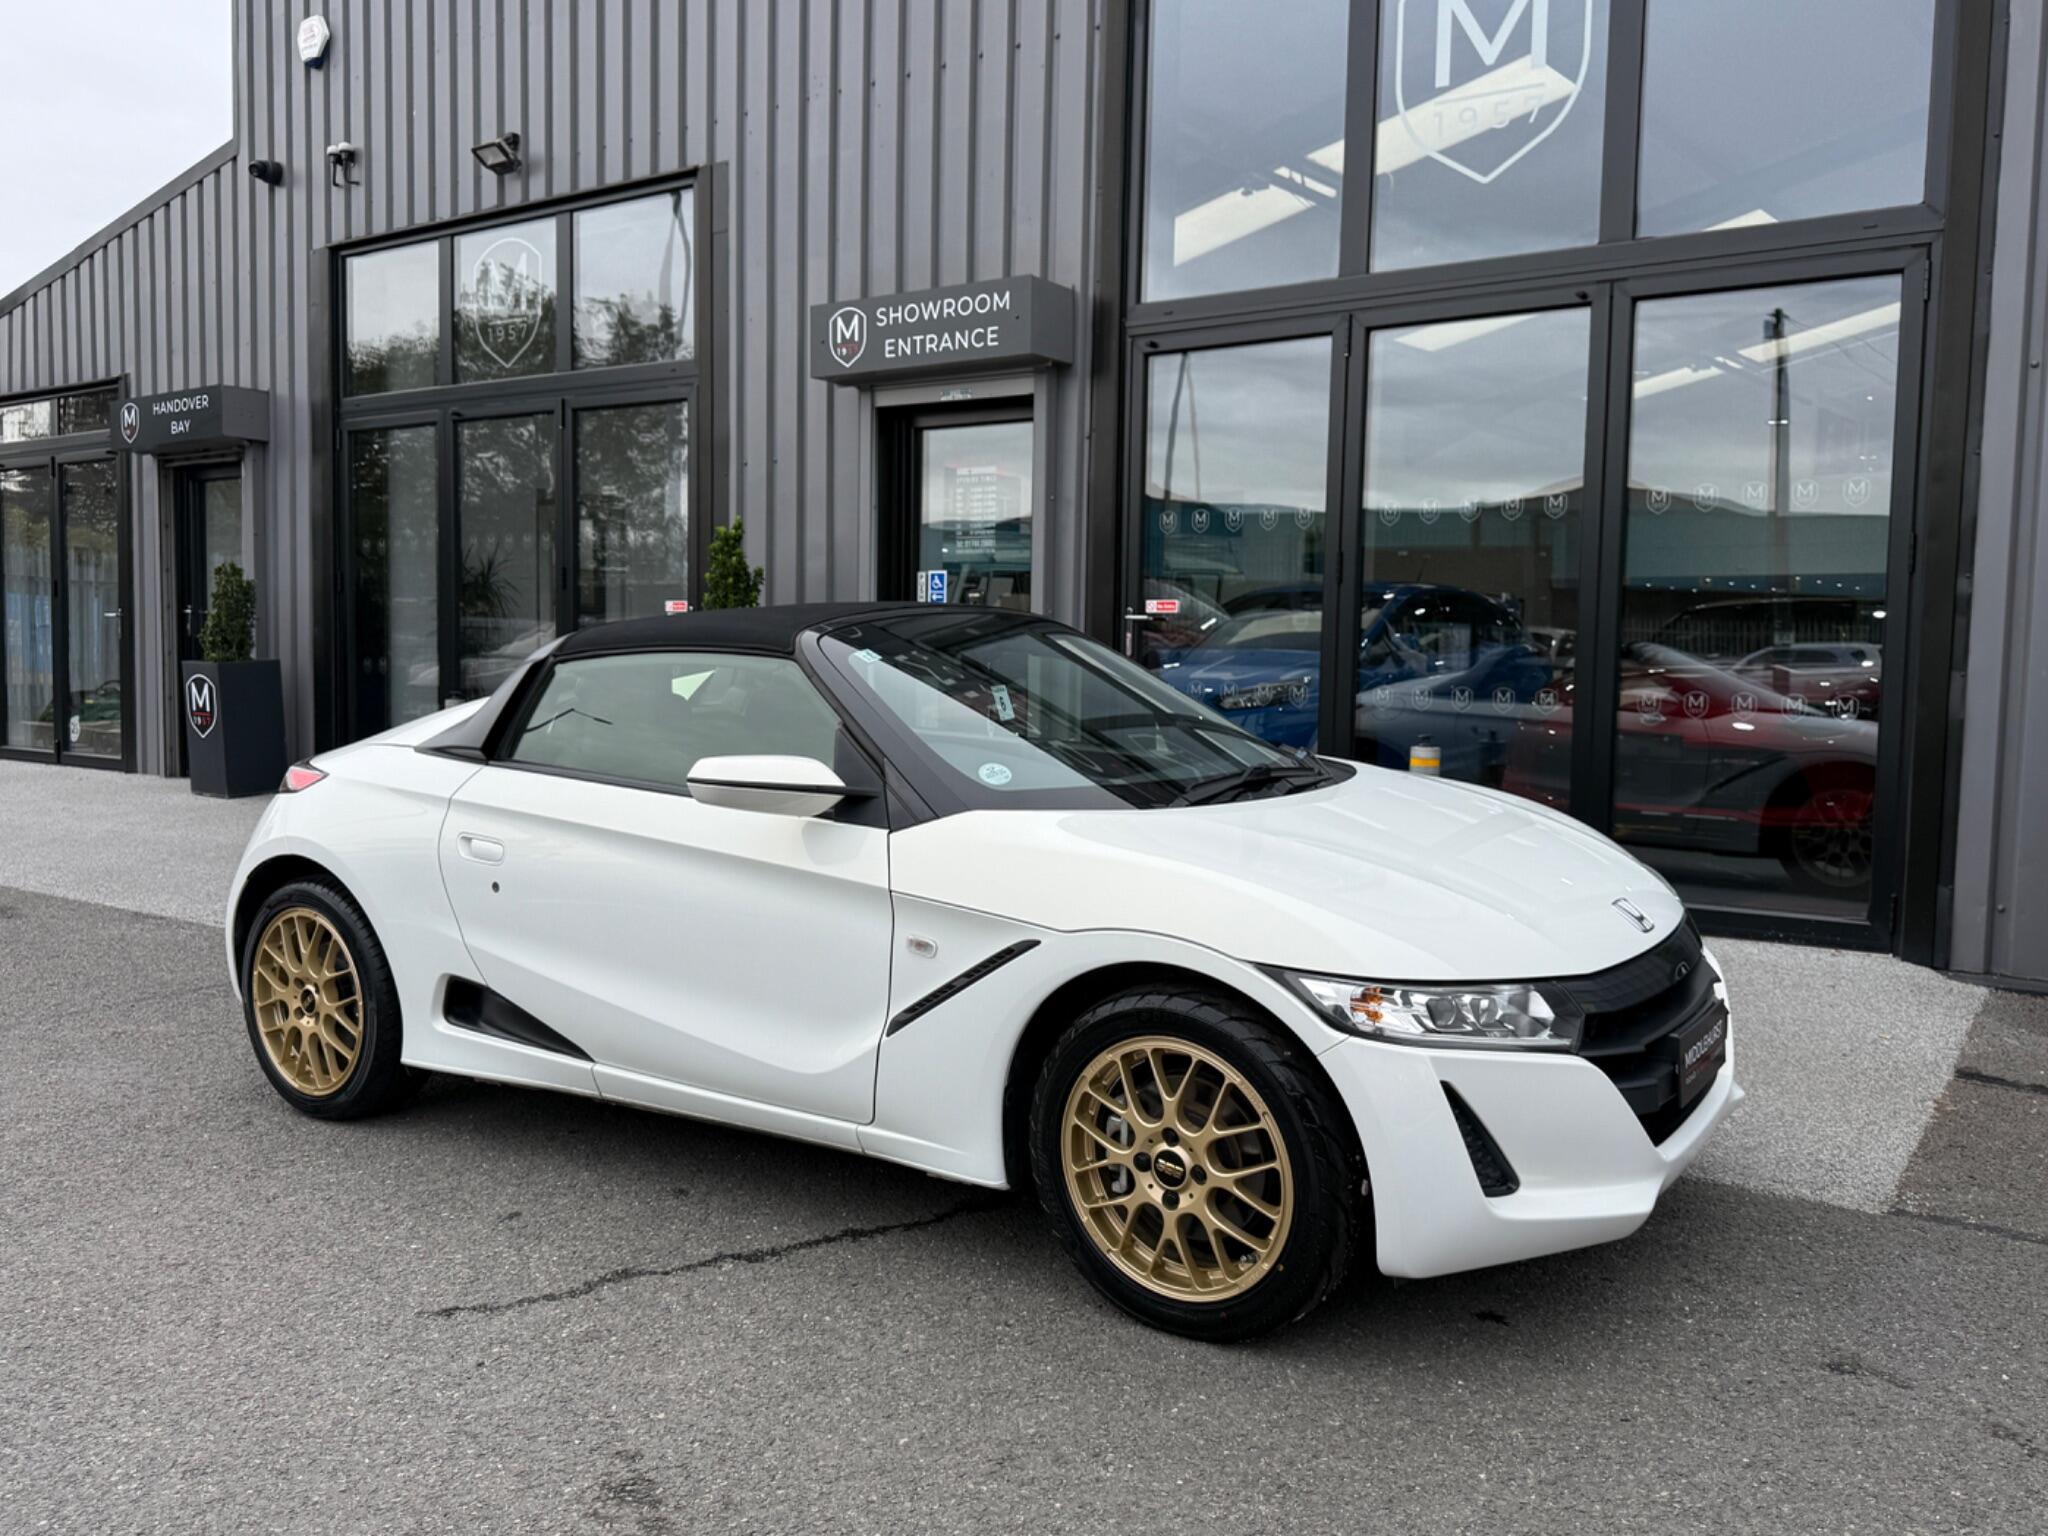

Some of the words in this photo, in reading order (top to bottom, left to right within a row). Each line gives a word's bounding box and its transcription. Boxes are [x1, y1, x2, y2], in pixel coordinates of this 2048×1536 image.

[1432, 94, 1545, 138] 1957
[875, 290, 1011, 327] SHOWROOM
[487, 323, 528, 343] 1957
[836, 313, 859, 344] M
[884, 326, 1000, 358] ENTRANCE
[123, 407, 136, 428] M
[152, 394, 209, 416] HANDOVER
[170, 420, 191, 435] BAY
[191, 681, 211, 711] M
